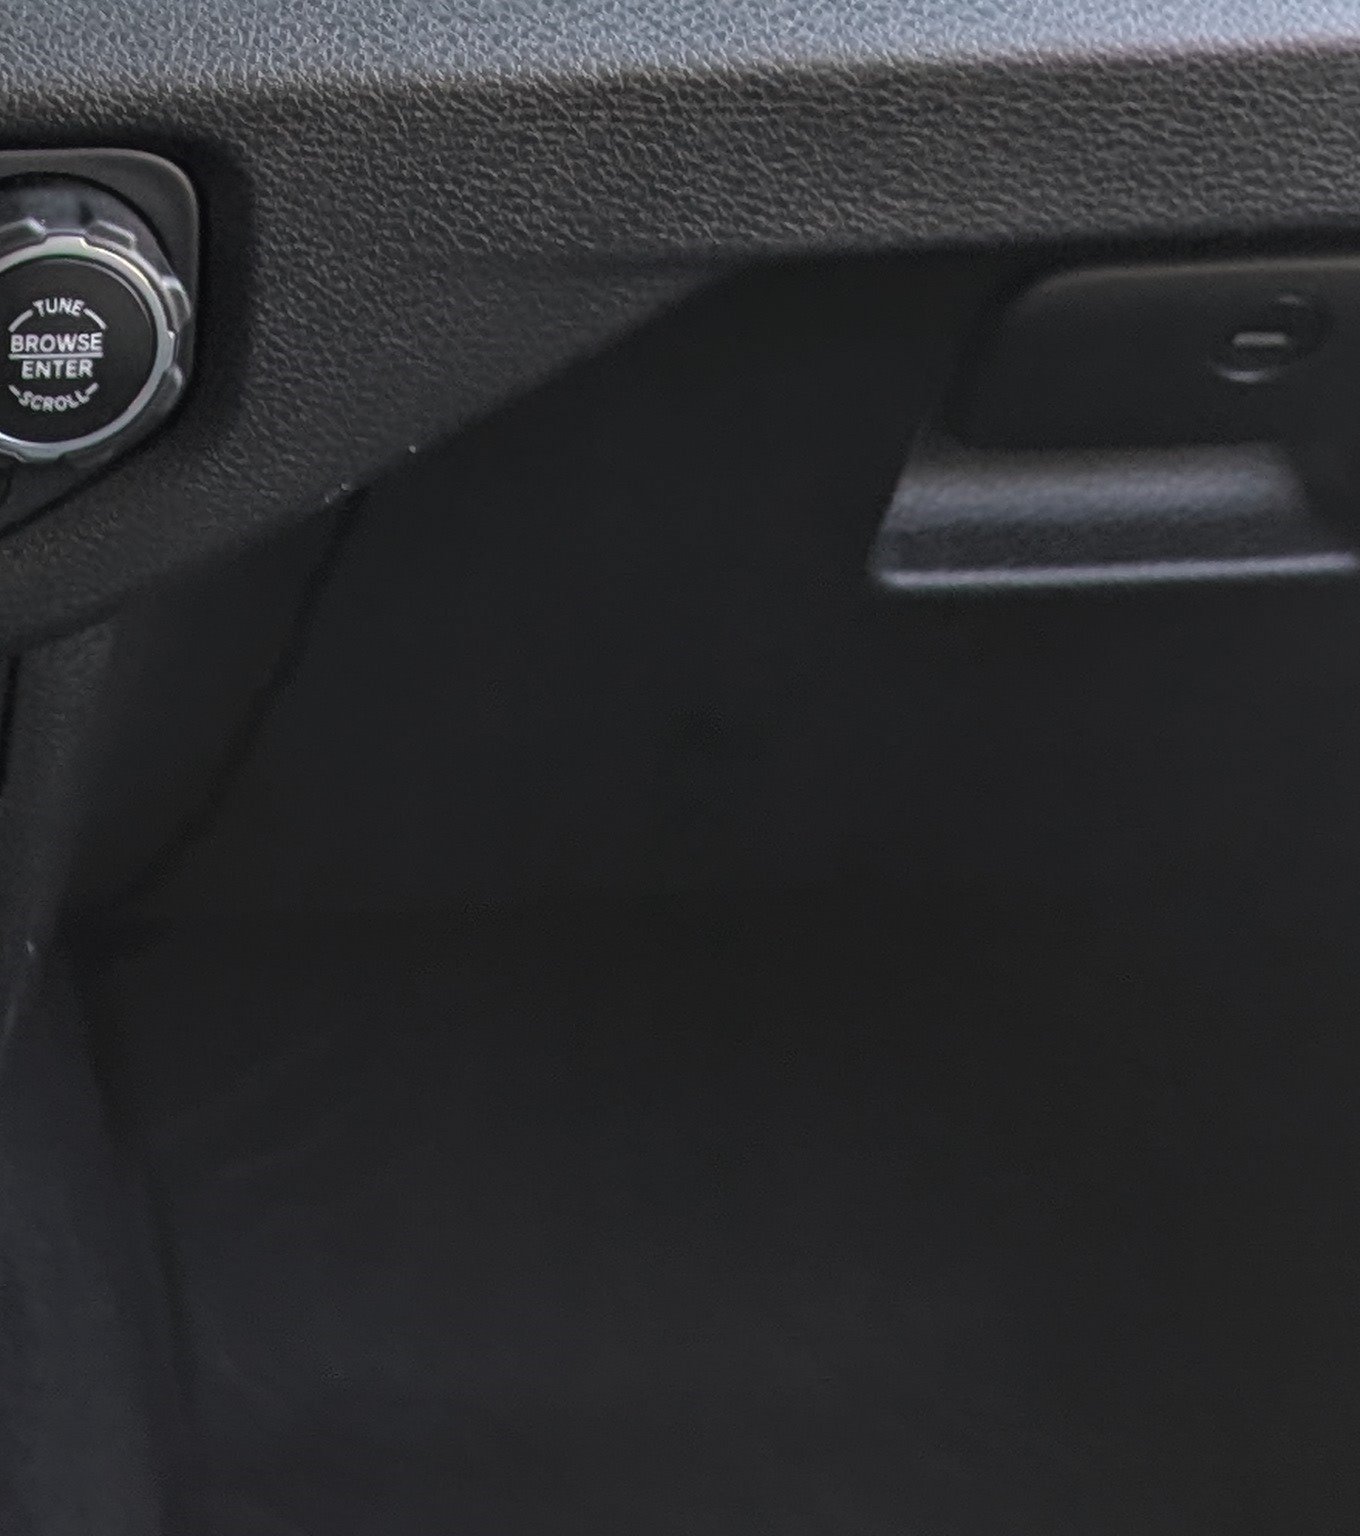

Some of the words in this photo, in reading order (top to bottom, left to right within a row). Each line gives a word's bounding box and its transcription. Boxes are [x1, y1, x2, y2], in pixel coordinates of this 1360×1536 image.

[33, 297, 85, 318] TUNE
[9, 332, 102, 354] BROWSE
[20, 359, 94, 379] ENTER
[16, 390, 87, 412] SCROLL
